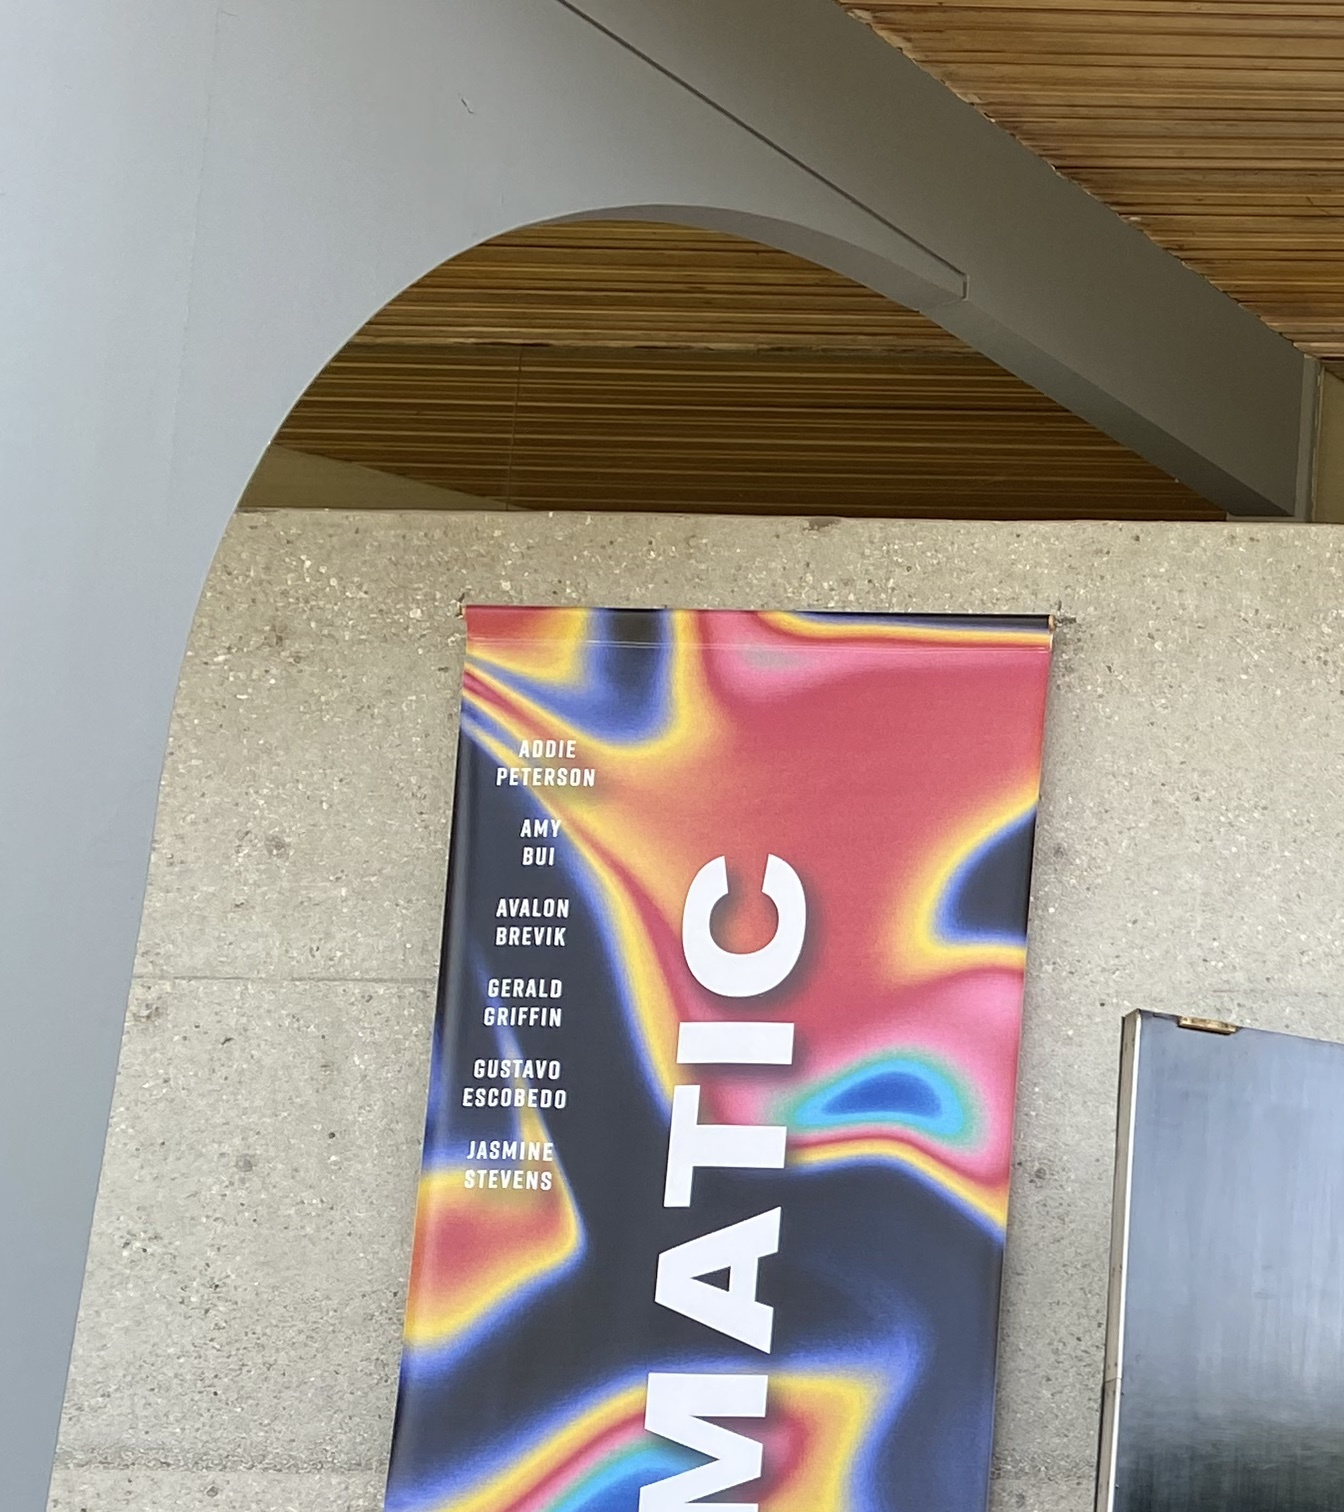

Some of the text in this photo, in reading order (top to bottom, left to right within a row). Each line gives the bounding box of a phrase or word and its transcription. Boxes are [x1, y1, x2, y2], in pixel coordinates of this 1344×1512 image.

[519, 740, 576, 759] ADDIE
[496, 767, 595, 787] PETERSON
[520, 819, 561, 838] AMY
[522, 847, 554, 865] BUI
[496, 898, 569, 918] AVALON
[495, 928, 566, 946] BREVIK
[488, 979, 563, 998] GERALD
[483, 1008, 562, 1026] GRIFFIN
[473, 1059, 560, 1079] GUSTAVO
[462, 1088, 566, 1108] ESCOBEDO
[466, 1141, 553, 1161] JASMINE
[464, 1170, 552, 1190] STEVENS
